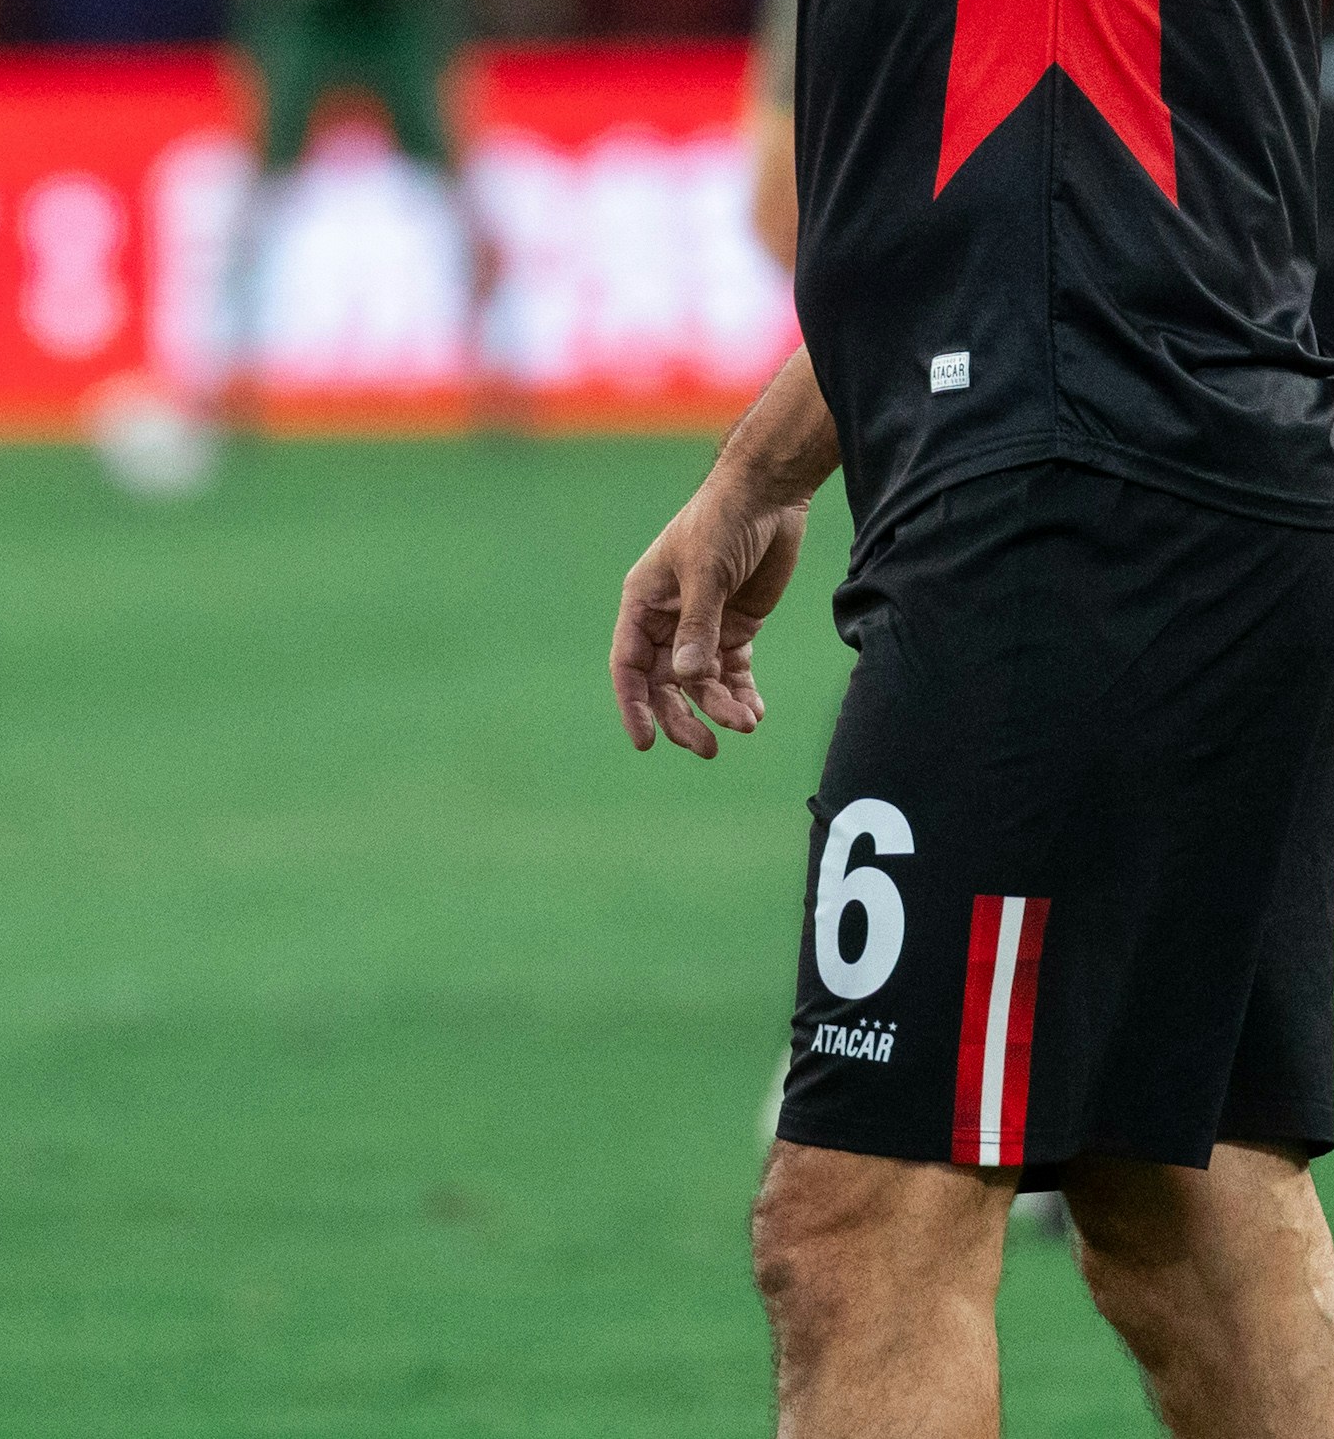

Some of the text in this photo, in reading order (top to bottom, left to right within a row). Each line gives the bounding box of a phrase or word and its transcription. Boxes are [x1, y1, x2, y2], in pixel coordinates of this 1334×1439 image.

[933, 363, 965, 379] ATACAR
[815, 798, 915, 1000] 6
[810, 1023, 895, 1063] ATACAR
